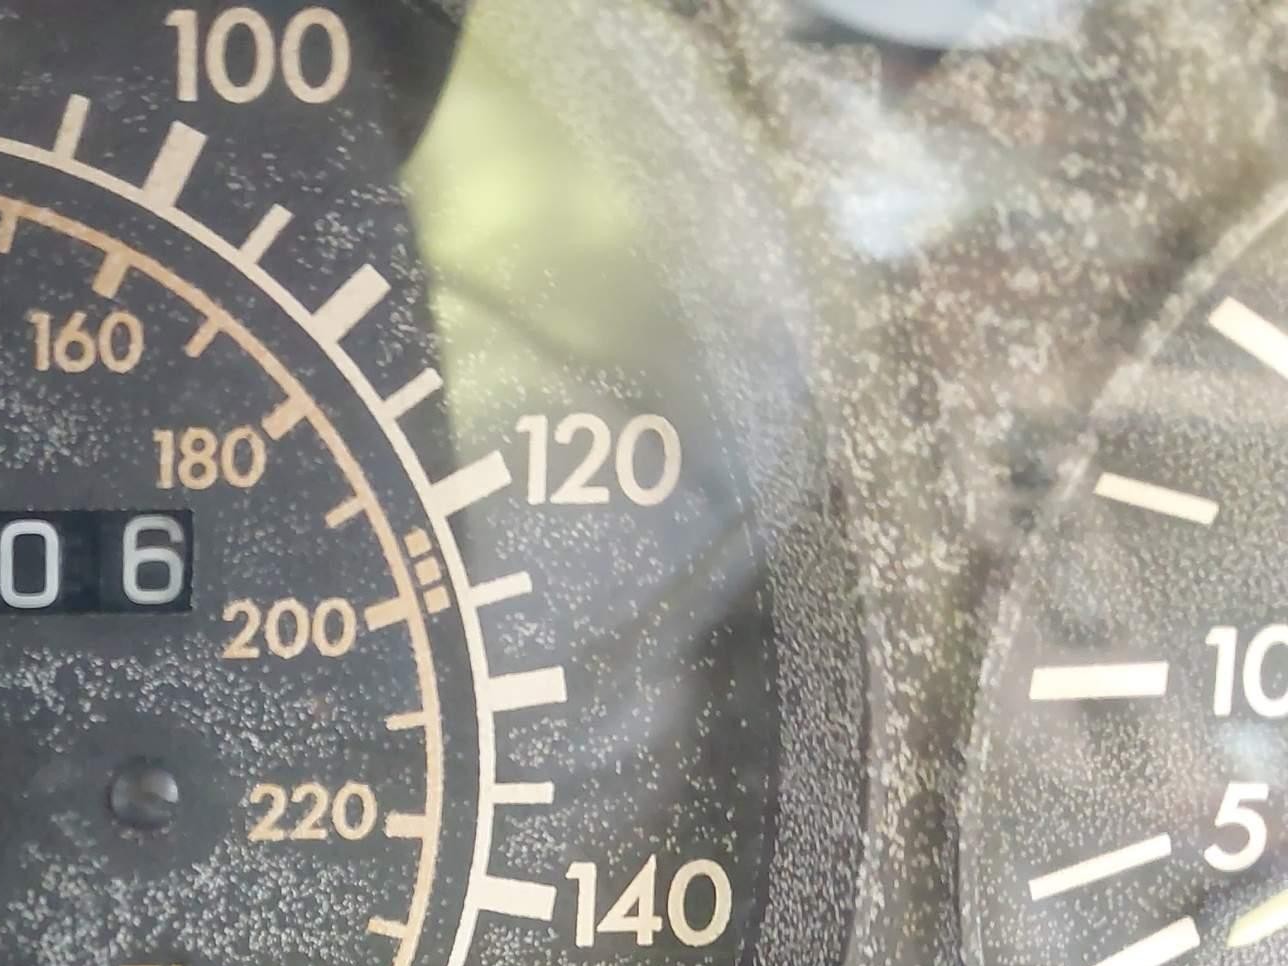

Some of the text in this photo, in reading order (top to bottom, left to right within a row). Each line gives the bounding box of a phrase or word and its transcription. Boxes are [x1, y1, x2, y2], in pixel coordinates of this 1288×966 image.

[165, 7, 351, 104] 100
[28, 311, 144, 374] 160
[153, 427, 267, 490] 180
[515, 412, 681, 506] 120
[221, 598, 359, 660] 200
[247, 781, 378, 843] 220
[1203, 781, 1269, 872] 5
[565, 855, 733, 949] 140
